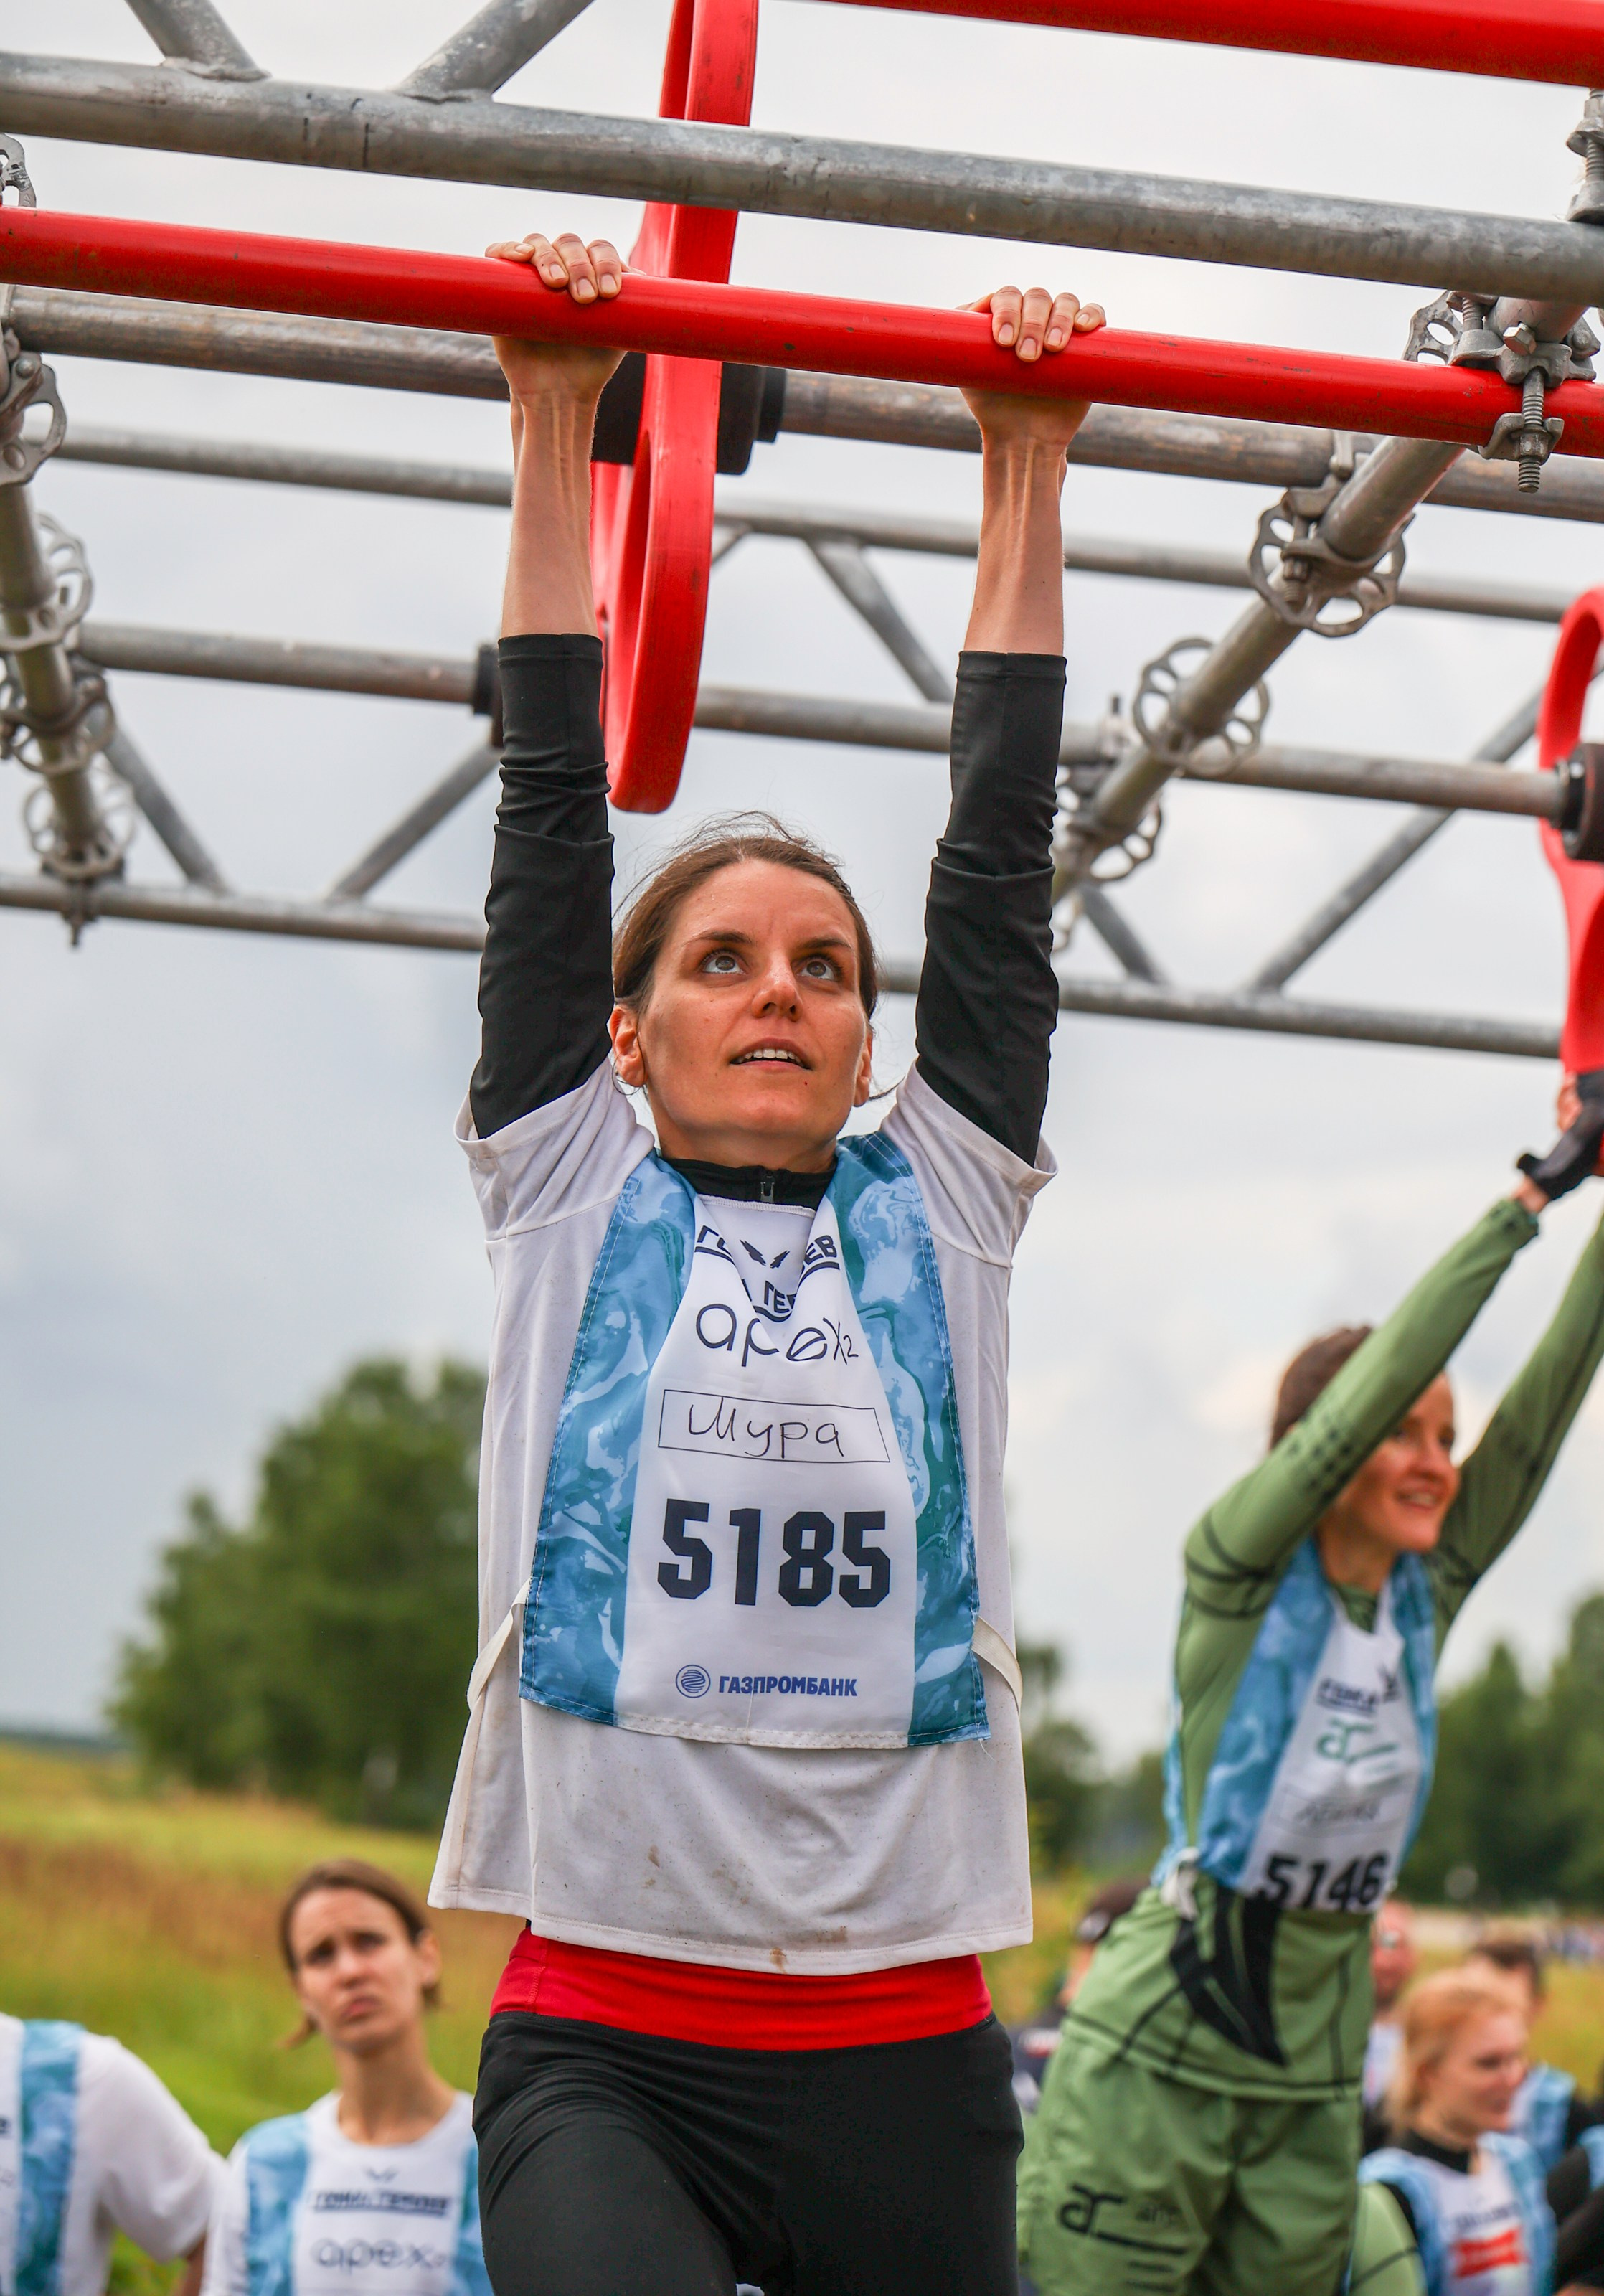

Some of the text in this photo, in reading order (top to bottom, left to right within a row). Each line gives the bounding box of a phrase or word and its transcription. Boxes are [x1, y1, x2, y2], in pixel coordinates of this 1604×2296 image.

[657, 1498, 891, 1608] 5185
[719, 1675, 858, 1697] ГАЗПРОМБАНК
[1259, 1850, 1389, 1911] 5146
